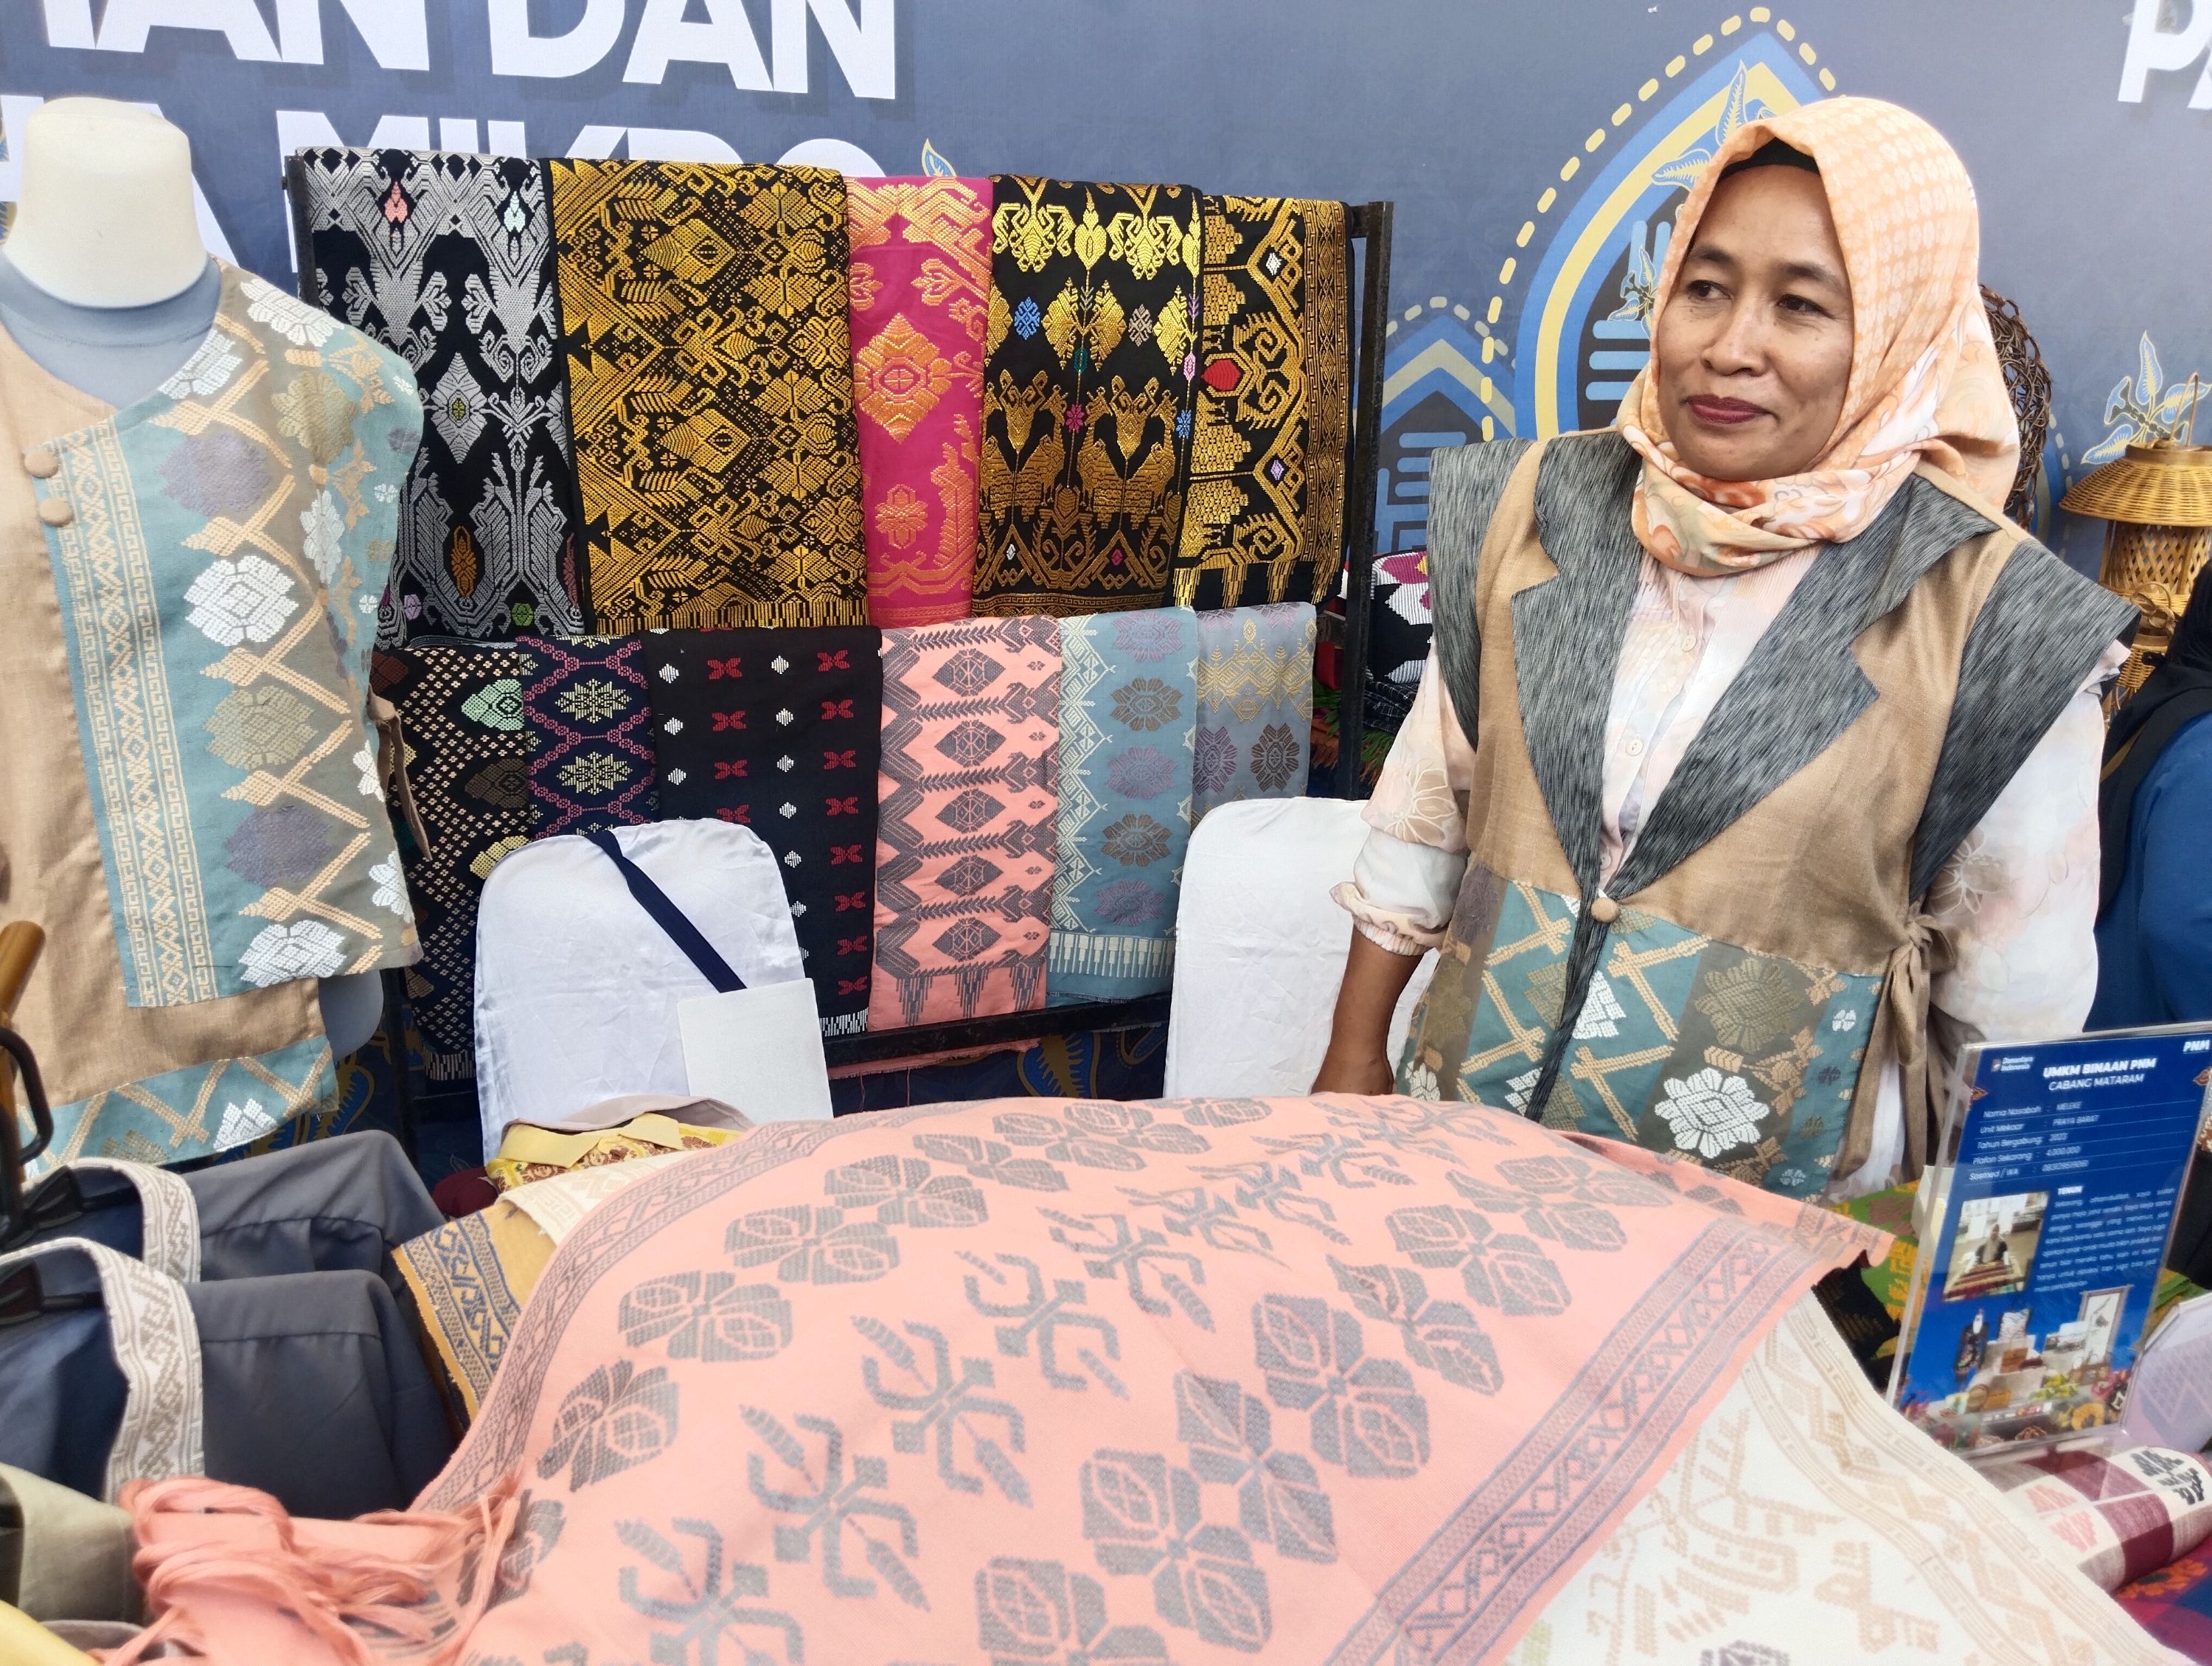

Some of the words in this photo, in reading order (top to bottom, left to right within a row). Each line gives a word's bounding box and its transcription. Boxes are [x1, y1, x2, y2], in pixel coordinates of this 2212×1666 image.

[2183, 1040, 2210, 1052] PNM
[2042, 1065, 2081, 1077] UMKM
[2081, 1060, 2129, 1074] BINAAN
[2129, 1058, 2157, 1069] PNM
[2048, 1078, 2092, 1091] CABANG
[2093, 1074, 2145, 1086] MATARAM
